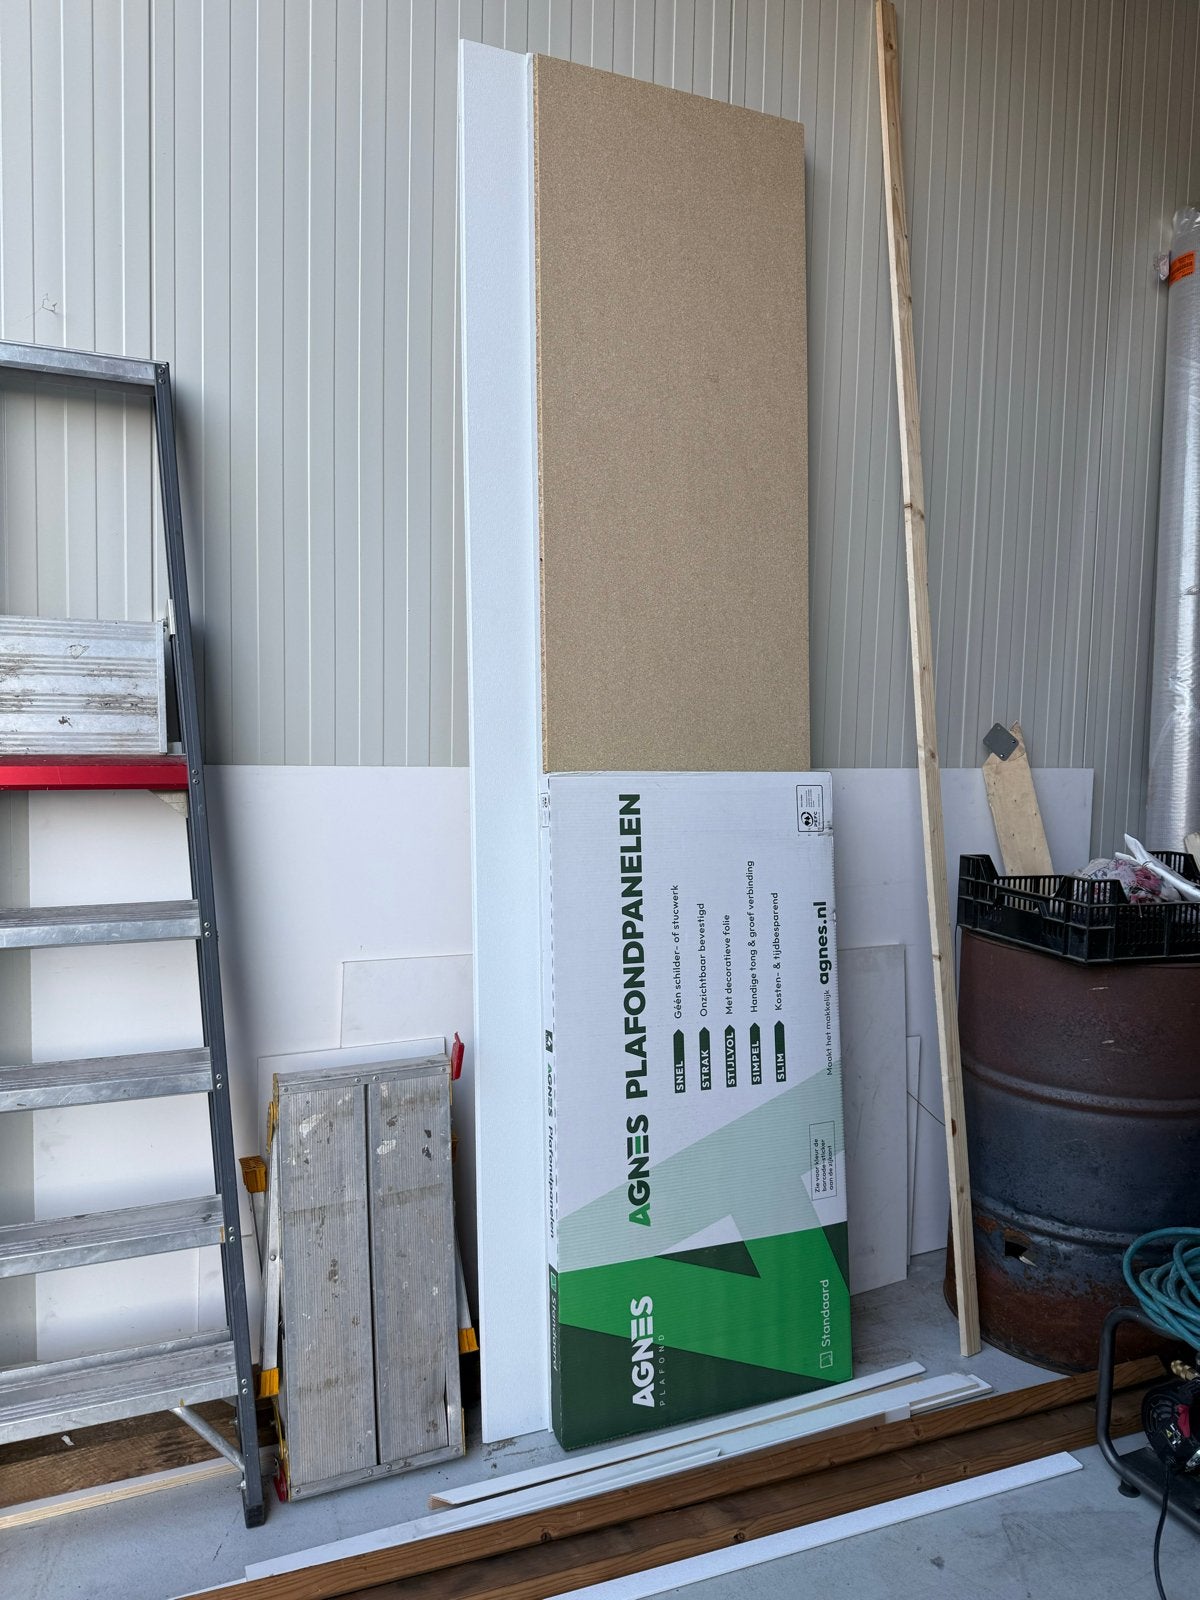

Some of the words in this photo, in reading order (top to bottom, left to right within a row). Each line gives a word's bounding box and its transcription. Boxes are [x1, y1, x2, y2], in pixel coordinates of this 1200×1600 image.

[745, 860, 755, 910] verbinding
[670, 884, 680, 930] stucwerk
[722, 914, 730, 936] folie
[746, 911, 757, 938] groef
[770, 892, 782, 960] tijdbesparend
[618, 794, 648, 1100] PLAFONDPANELEN
[671, 932, 680, 943] of
[696, 903, 707, 952] bevestigd
[747, 939, 756, 947] &
[813, 901, 832, 985] agnes.nl
[672, 945, 682, 990] schilder-
[723, 937, 733, 994] decoratieve
[749, 949, 758, 971] tong
[772, 961, 781, 970] &
[673, 992, 682, 1019] Géén
[698, 954, 708, 1017] Onzichtbaar
[749, 973, 759, 1013] Handige
[774, 972, 782, 1011] Kosten-
[725, 1000, 733, 1015] Met
[823, 989, 832, 1030] makkelijk
[675, 1060, 684, 1091] SNEL
[700, 1049, 710, 1088] STRAK
[726, 1031, 735, 1085] STIJLVOL
[751, 1040, 760, 1083] SIMPEL
[776, 1053, 785, 1080] SLIM
[825, 1048, 833, 1076] Maakt
[813, 1138, 819, 1147] de
[626, 1113, 651, 1227] AGNES
[828, 1168, 833, 1177] de
[819, 1279, 831, 1347] Standaard
[630, 1295, 655, 1408] AGNES
[658, 1334, 666, 1407] PLAFOND
